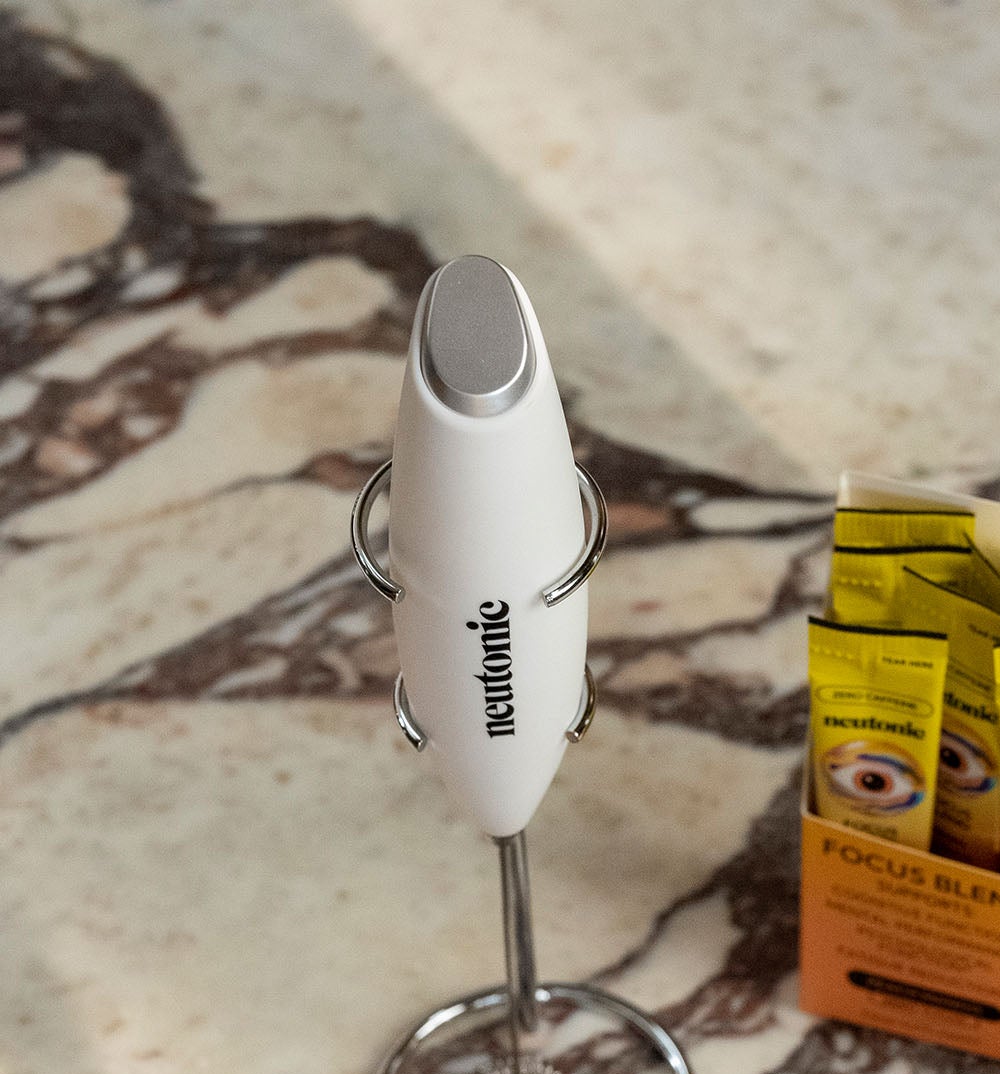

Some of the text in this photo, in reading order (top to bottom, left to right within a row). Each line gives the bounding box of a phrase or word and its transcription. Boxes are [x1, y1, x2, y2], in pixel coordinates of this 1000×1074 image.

[466, 600, 515, 739] neutonic
[824, 715, 926, 740] neutonic
[823, 838, 926, 886] FOCUS
